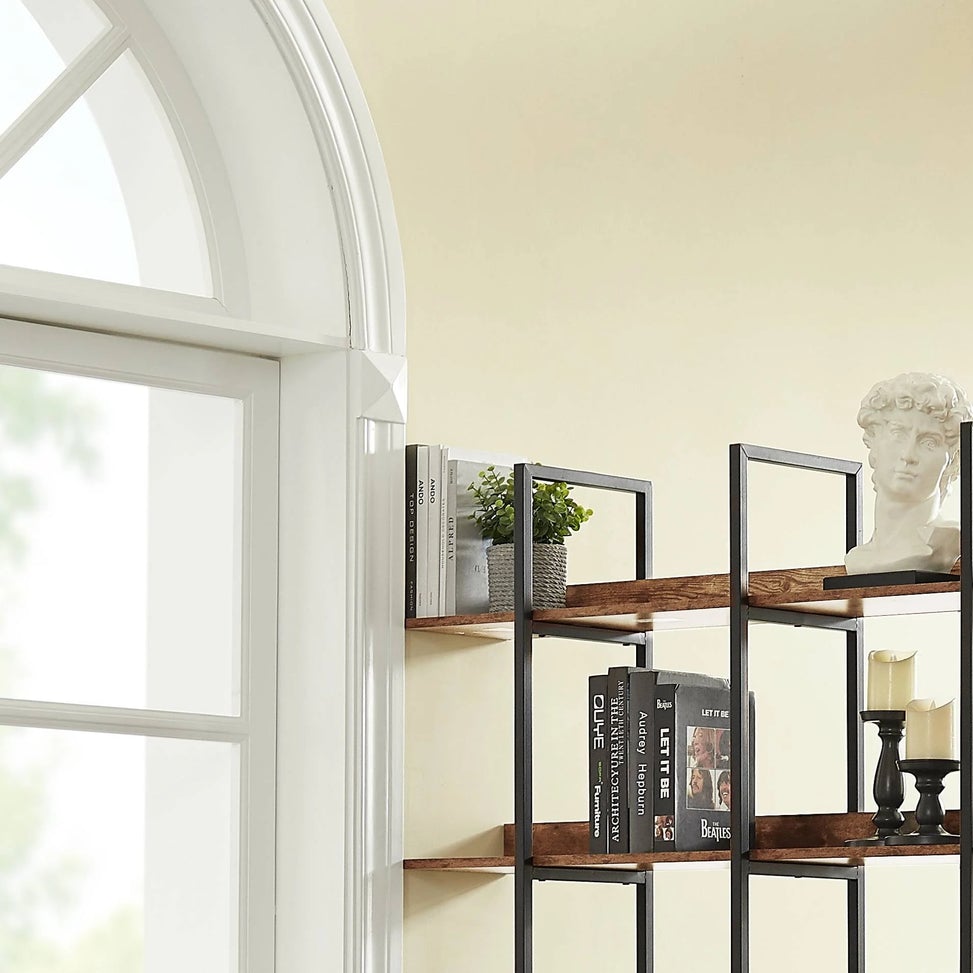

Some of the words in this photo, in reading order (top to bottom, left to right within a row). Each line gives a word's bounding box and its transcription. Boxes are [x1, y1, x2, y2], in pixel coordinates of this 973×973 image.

[610, 697, 619, 725] THE
[617, 680, 625, 717] CENTURY
[701, 708, 713, 717] LET
[713, 709, 720, 718] IT
[720, 710, 729, 718] BE
[610, 726, 619, 741] IN
[636, 711, 648, 755] Audrey
[660, 727, 670, 757] LET
[660, 760, 670, 775] IT
[610, 743, 620, 842] ARCHITECYURE
[636, 764, 647, 816] Hepburn
[660, 777, 670, 799] BE
